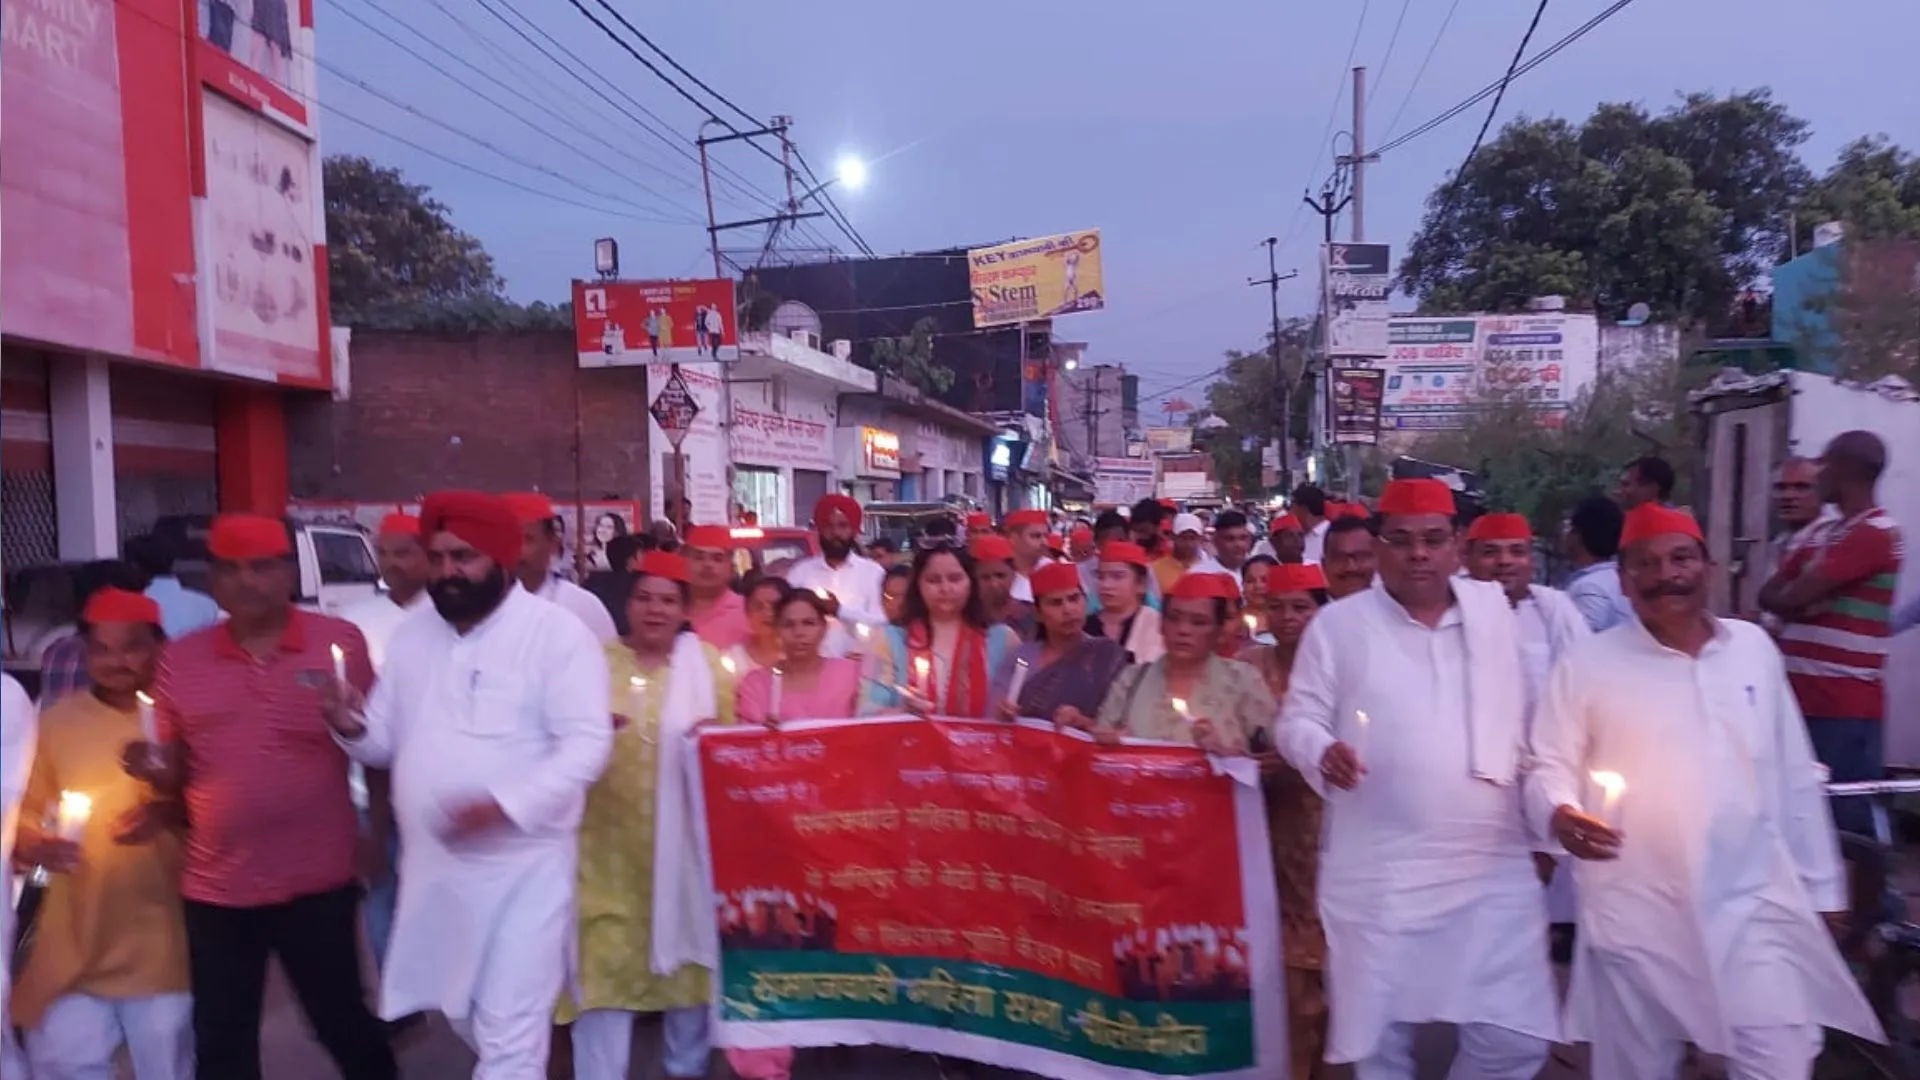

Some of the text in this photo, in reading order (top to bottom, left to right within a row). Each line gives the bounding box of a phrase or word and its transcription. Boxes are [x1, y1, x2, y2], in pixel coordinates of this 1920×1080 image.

[973, 251, 1006, 267] KEY
[904, 801, 972, 834] महिला
[750, 962, 898, 1005] समाजवादी
[904, 966, 997, 1018] महिला
